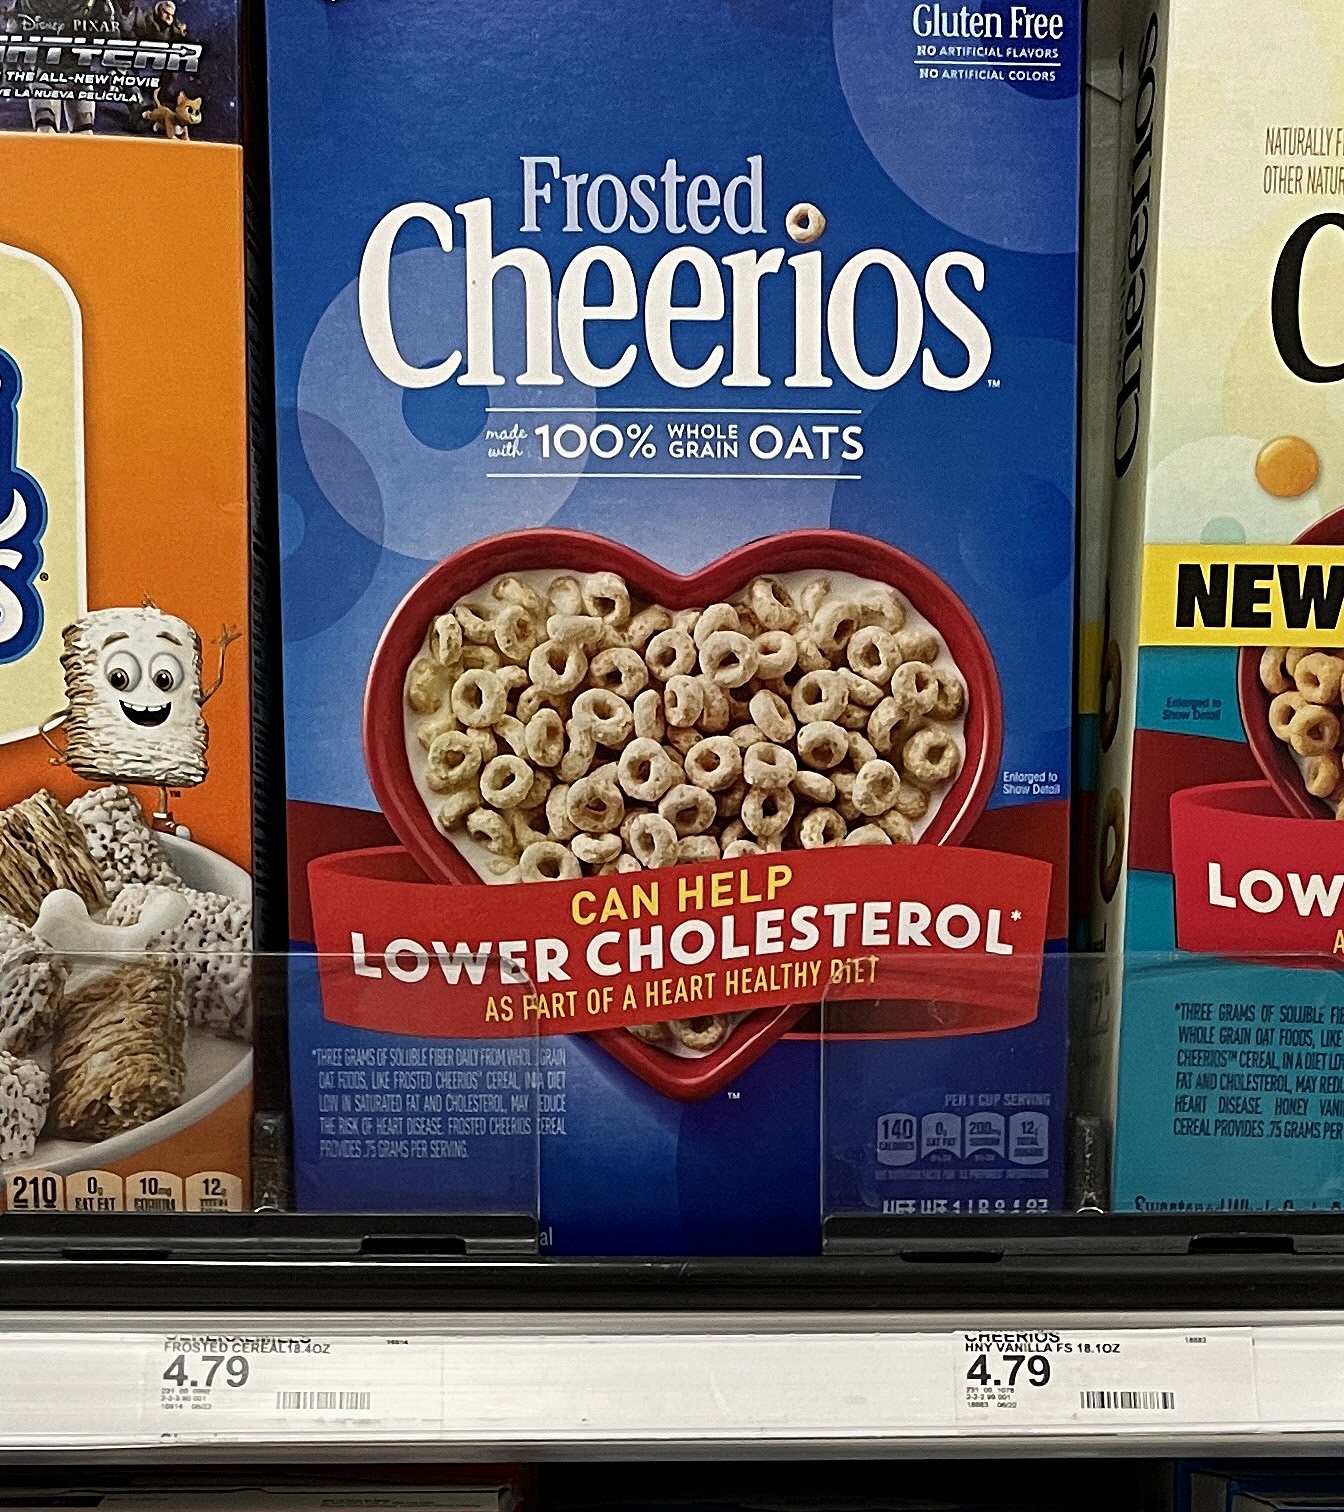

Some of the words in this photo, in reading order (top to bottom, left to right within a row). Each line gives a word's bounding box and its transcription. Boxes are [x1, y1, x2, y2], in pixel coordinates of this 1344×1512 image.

[913, 5, 1002, 38] Gluten
[1009, 7, 1062, 39] Free
[1265, 129, 1332, 157] NATURALLY
[520, 156, 767, 234] Frosted
[1263, 166, 1303, 194] OTHER
[359, 199, 993, 390] Cheerios
[535, 425, 657, 459] 100%
[750, 426, 864, 460] OATS
[667, 424, 738, 440] WHOLE
[668, 442, 738, 458] GRAIN
[572, 886, 661, 925] CAN
[678, 866, 793, 911] HELP
[352, 932, 568, 985] LOWER
[486, 997, 515, 1021] AS
[523, 990, 575, 1018] PART
[587, 987, 616, 1012] OF
[622, 983, 637, 1007] A
[646, 973, 715, 1005] HEART
[724, 962, 823, 996] HEALTHY
[831, 955, 878, 985] DIET
[965, 1343, 993, 1352] HNY
[996, 1343, 1052, 1353] VANILLA
[1057, 1344, 1072, 1352] FS
[163, 1355, 249, 1387] 4.79
[966, 1355, 1050, 1386] 4.79
